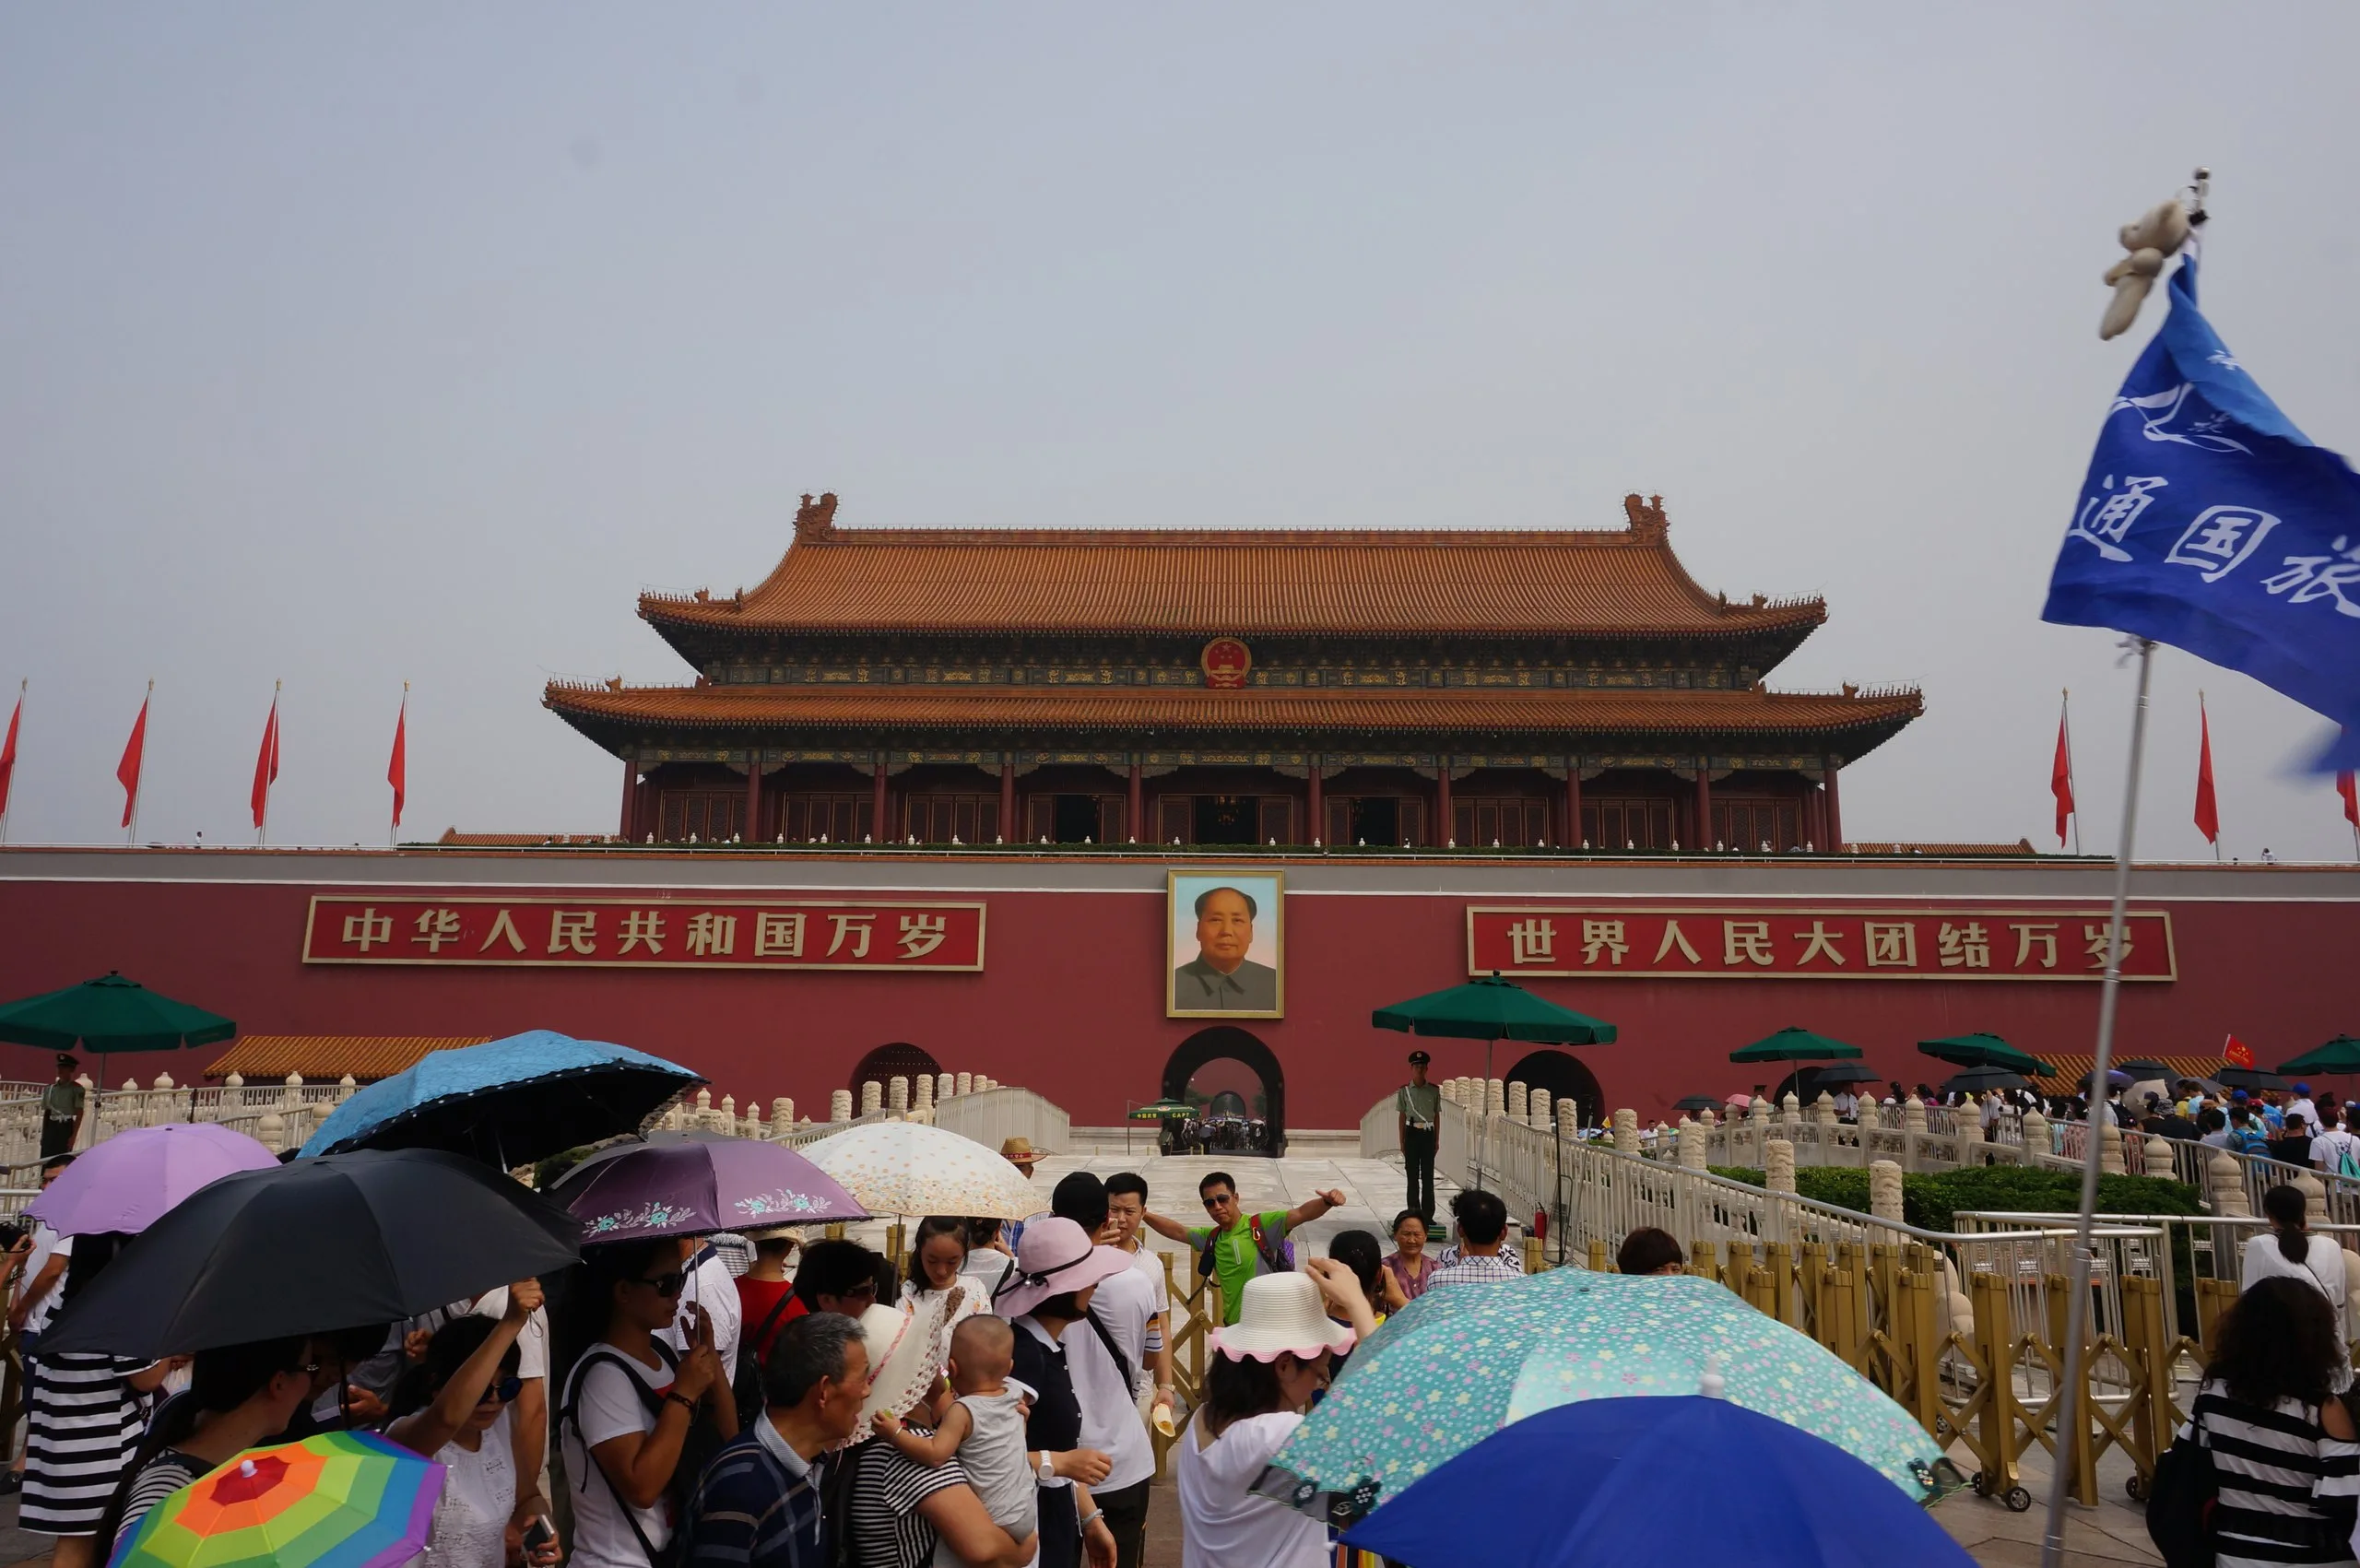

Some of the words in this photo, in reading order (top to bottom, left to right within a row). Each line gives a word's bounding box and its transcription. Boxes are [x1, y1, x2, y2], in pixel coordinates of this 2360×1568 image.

[341, 908, 948, 960] 中华人民共和国万岁
[1506, 919, 2135, 969] 世界人民大团结万岁
